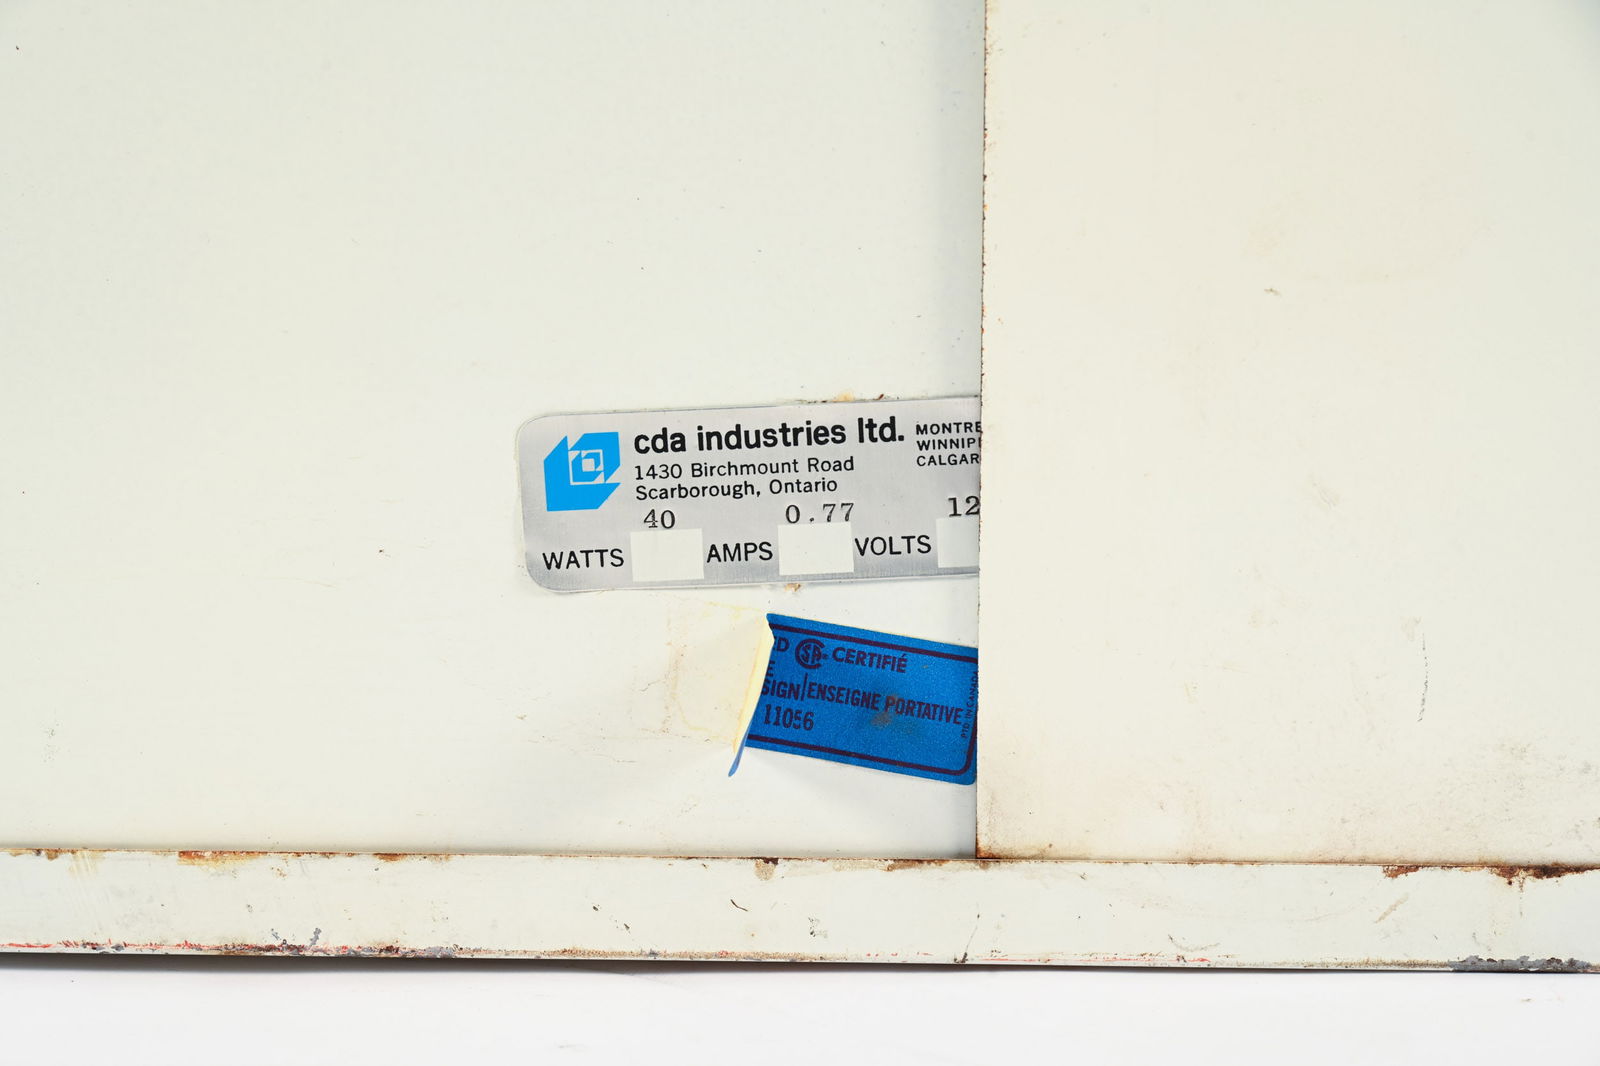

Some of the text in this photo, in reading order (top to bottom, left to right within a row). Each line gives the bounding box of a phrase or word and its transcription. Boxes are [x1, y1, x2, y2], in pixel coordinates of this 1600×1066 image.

[634, 416, 905, 454] cda industries ltd.
[917, 438, 981, 451] WINNIP
[635, 456, 854, 480] 1430 Birchmount Road
[636, 477, 838, 500] Scarborough, Ontario
[643, 509, 676, 529] 40
[706, 541, 773, 563] AMPS
[855, 535, 932, 556] VOLTS
[542, 548, 624, 570] WATTS
[832, 646, 908, 674] CERTIFIÉ
[764, 704, 815, 731] 11056
[885, 696, 964, 725] PORTATIVE
